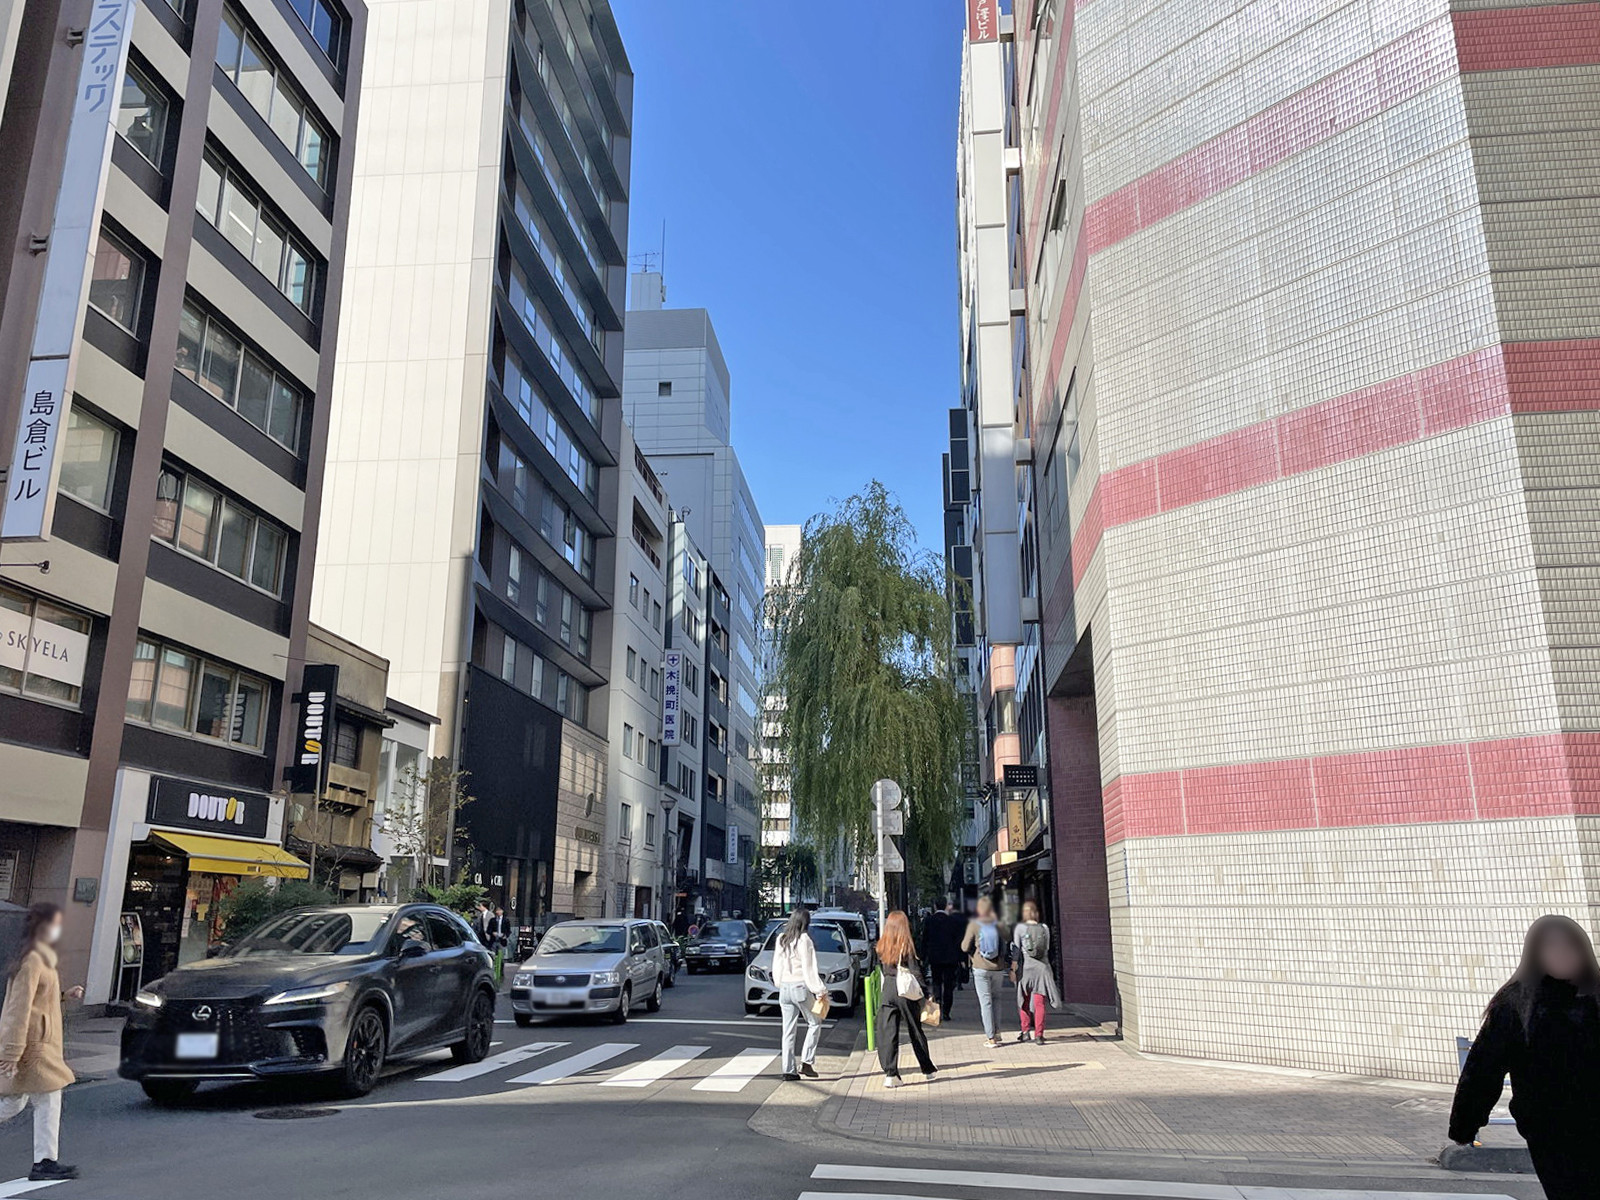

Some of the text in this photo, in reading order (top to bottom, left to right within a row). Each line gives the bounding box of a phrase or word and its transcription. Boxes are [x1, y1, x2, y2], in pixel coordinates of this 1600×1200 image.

[84, 0, 122, 112] ステック
[14, 389, 55, 501] 島倉ビル
[300, 691, 327, 765] DOUTOR
[664, 670, 677, 740] 木挽町医院
[187, 792, 245, 825] DOUTOR
